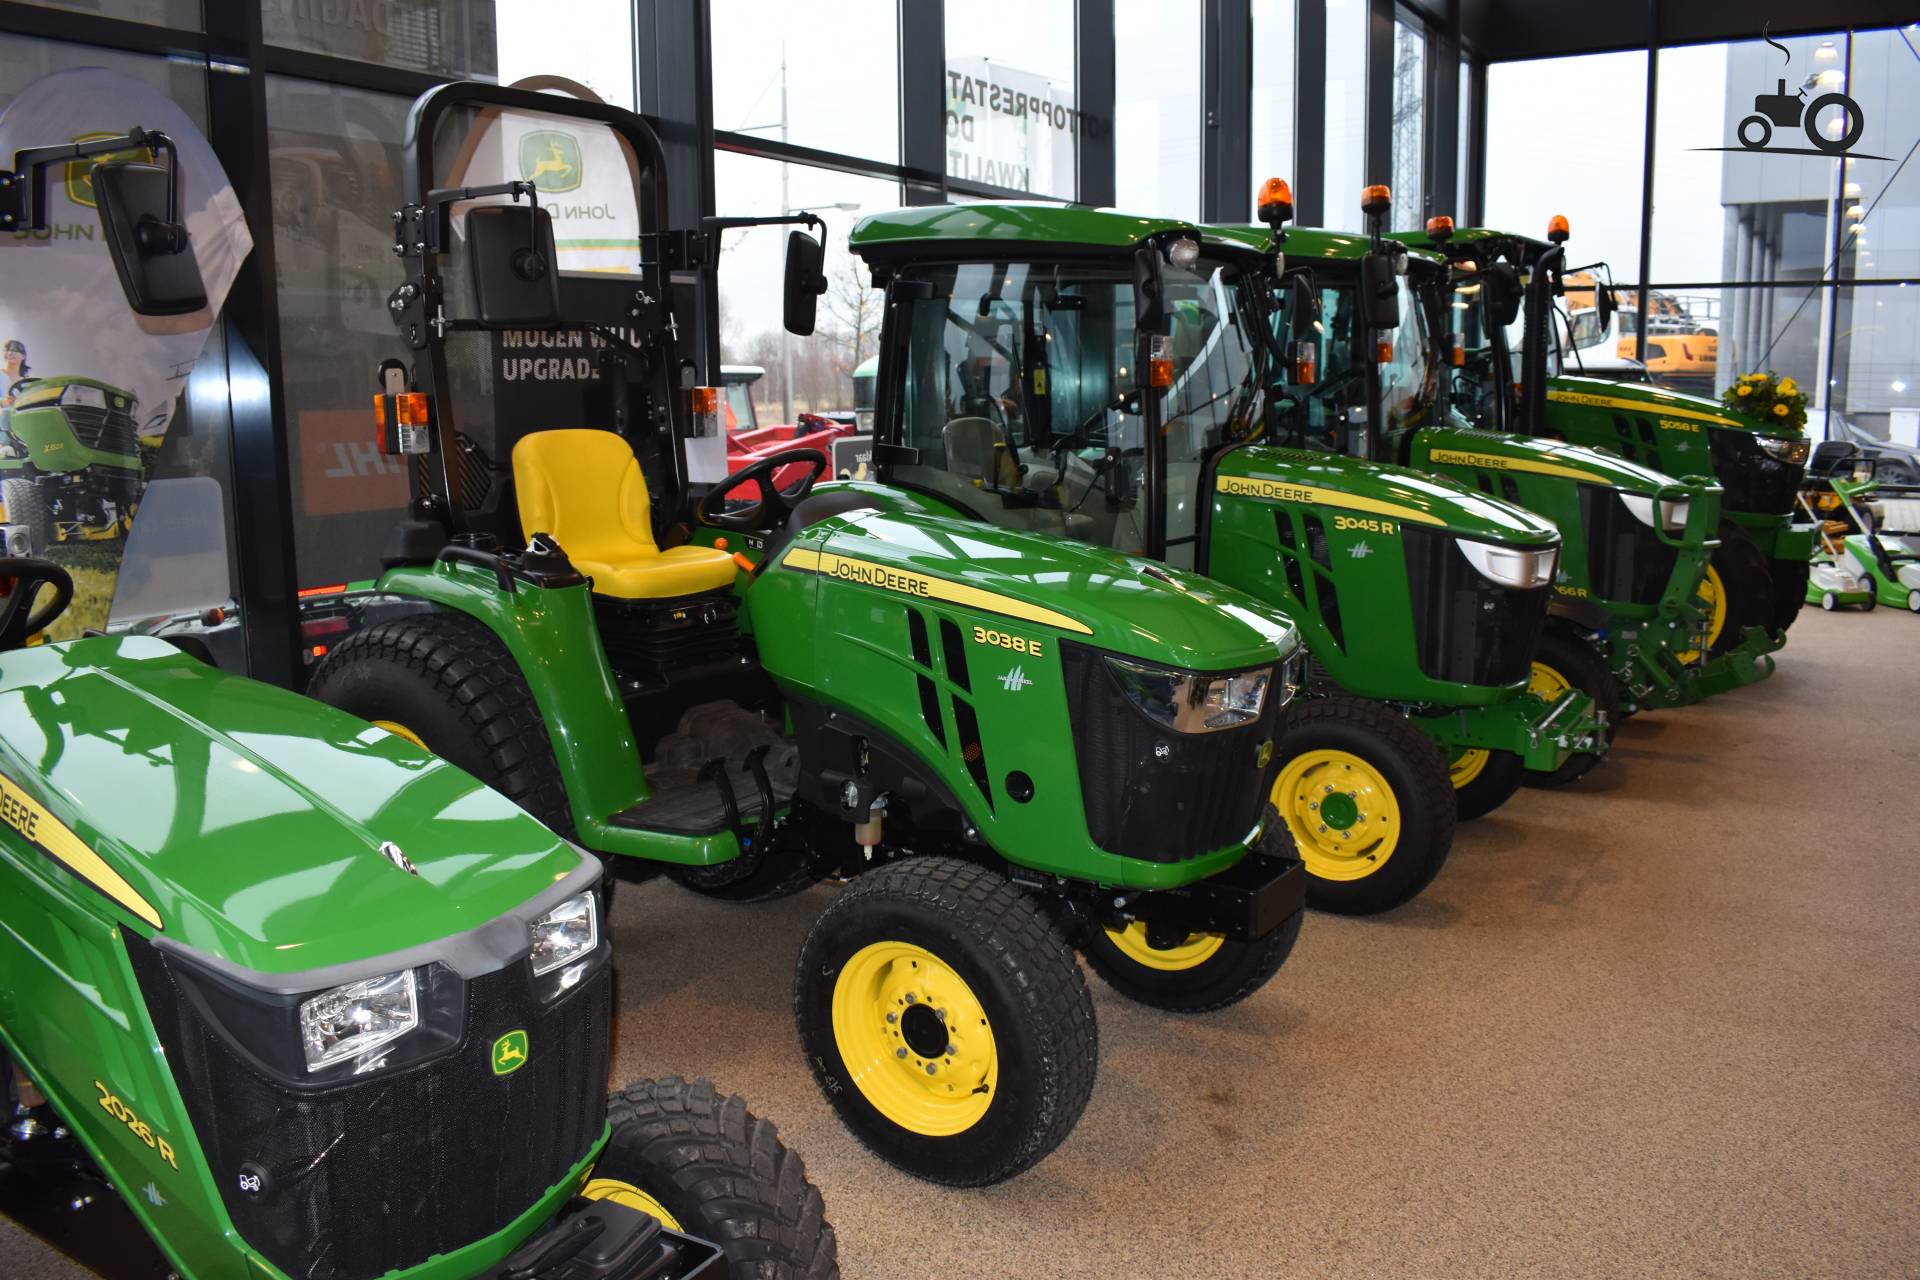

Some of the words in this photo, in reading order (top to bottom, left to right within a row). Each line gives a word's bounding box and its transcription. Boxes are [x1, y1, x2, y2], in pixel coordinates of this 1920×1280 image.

[1435, 452, 1465, 464] JOHN
[1467, 455, 1508, 468] DEERE
[1222, 480, 1261, 496] JOHN
[1262, 484, 1313, 502] DEERE
[1334, 515, 1380, 532] 3045
[1381, 522, 1394, 535] R
[830, 559, 872, 583] JOHN
[874, 567, 929, 595] DEERE
[973, 625, 1027, 653] 3038
[1028, 639, 1043, 657] E
[94, 1080, 155, 1149] 2026
